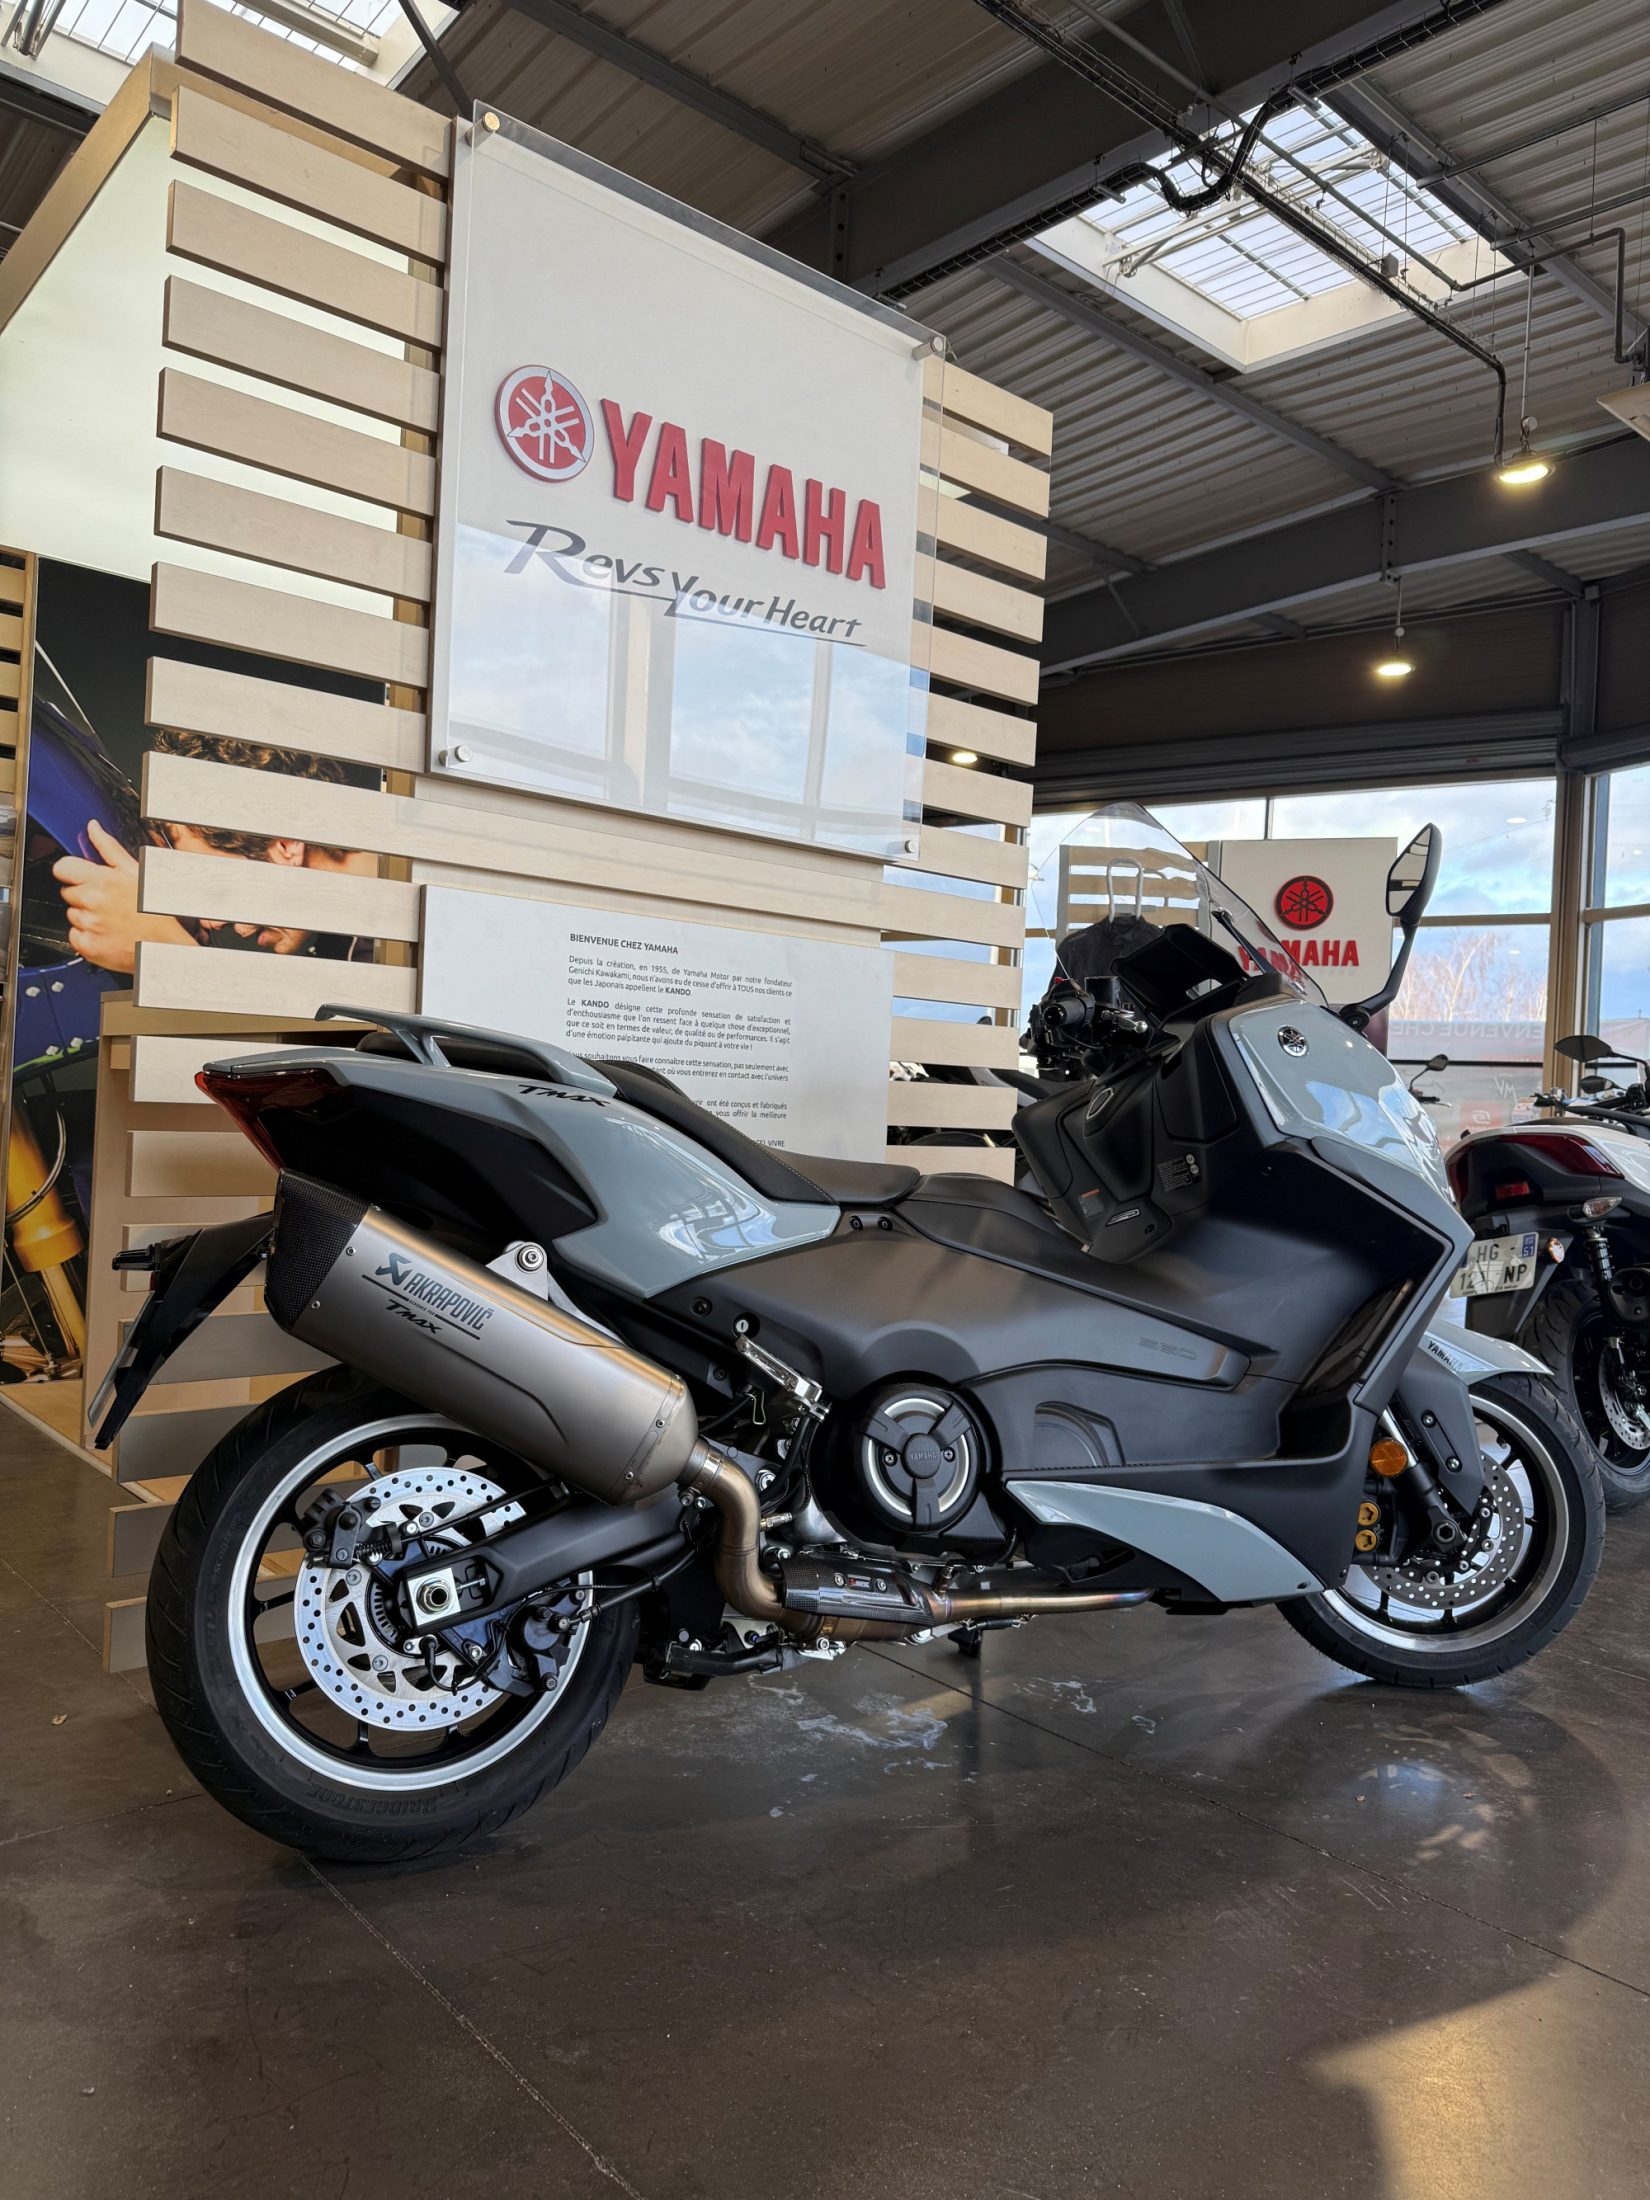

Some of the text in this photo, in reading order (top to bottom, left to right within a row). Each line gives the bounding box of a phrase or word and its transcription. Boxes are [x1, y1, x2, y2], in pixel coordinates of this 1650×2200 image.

[600, 398, 886, 589] YAMAHA
[504, 519, 862, 638] Revs Your Heart
[570, 933, 679, 954] BIENVENUE CHEZ YAMAHA
[568, 966, 594, 976] Genichi
[596, 969, 631, 981] Kawakami,
[649, 975, 673, 985] n'avons
[683, 978, 692, 986] de
[710, 981, 732, 991] d'offrir
[732, 983, 736, 991] à
[737, 984, 754, 993] TOUS
[766, 987, 785, 996] clients
[569, 955, 593, 966] Depuis
[596, 958, 603, 966] la
[606, 960, 636, 971] création,
[651, 964, 668, 975] 1955,
[672, 967, 680, 975] de
[683, 968, 708, 978] Yamaha
[710, 971, 730, 980] Motor
[732, 975, 742, 983] par
[745, 976, 761, 984] notre
[764, 977, 792, 988] fondateur
[568, 978, 582, 986] que
[583, 978, 593, 986] les
[594, 979, 624, 989] Japonais
[625, 983, 656, 992] appellent
[657, 985, 664, 993] le
[568, 998, 576, 1006] Le
[581, 999, 610, 1009] KANDO
[614, 1002, 641, 1013] désigne
[646, 1005, 663, 1014] cette
[668, 1008, 697, 1017] profonde
[702, 1011, 730, 1020] sensation
[735, 1013, 743, 1021] de
[747, 1014, 781, 1024] satisfaction
[566, 1008, 791, 1036] d'enthousiasme que l'on ressent face à quelque chose d'exceptionnel,
[566, 1021, 580, 1029] que
[616, 1023, 640, 1032] termes
[642, 1025, 651, 1033] de
[652, 1026, 673, 1036] valeur,
[684, 1029, 706, 1038] qualité
[717, 1031, 725, 1039] de
[726, 1032, 768, 1042] performances.
[774, 1036, 790, 1045] s'agit
[566, 1030, 585, 1038] d'une
[586, 1031, 615, 1040] émotion
[616, 1034, 651, 1043] palpitante
[652, 1036, 662, 1045] qui
[663, 1037, 684, 1046] ajoute
[685, 1038, 692, 1046] du
[694, 1039, 718, 1049] piquant
[584, 1052, 620, 1061] souhaitons
[639, 1055, 653, 1063] faire
[654, 1057, 684, 1065] connaître
[702, 1060, 732, 1070] sensation,
[733, 1063, 744, 1071] pas
[745, 1063, 775, 1071] seulement
[692, 1069, 718, 1078] entrerez
[728, 1071, 750, 1079] contact
[764, 1073, 789, 1081] l'univers
[730, 1102, 751, 1110] conçus
[732, 1110, 749, 1118] offrir
[760, 1111, 787, 1119] meilleure
[768, 1139, 785, 1147] VIVRE
[1503, 1263, 1527, 1284] NP
